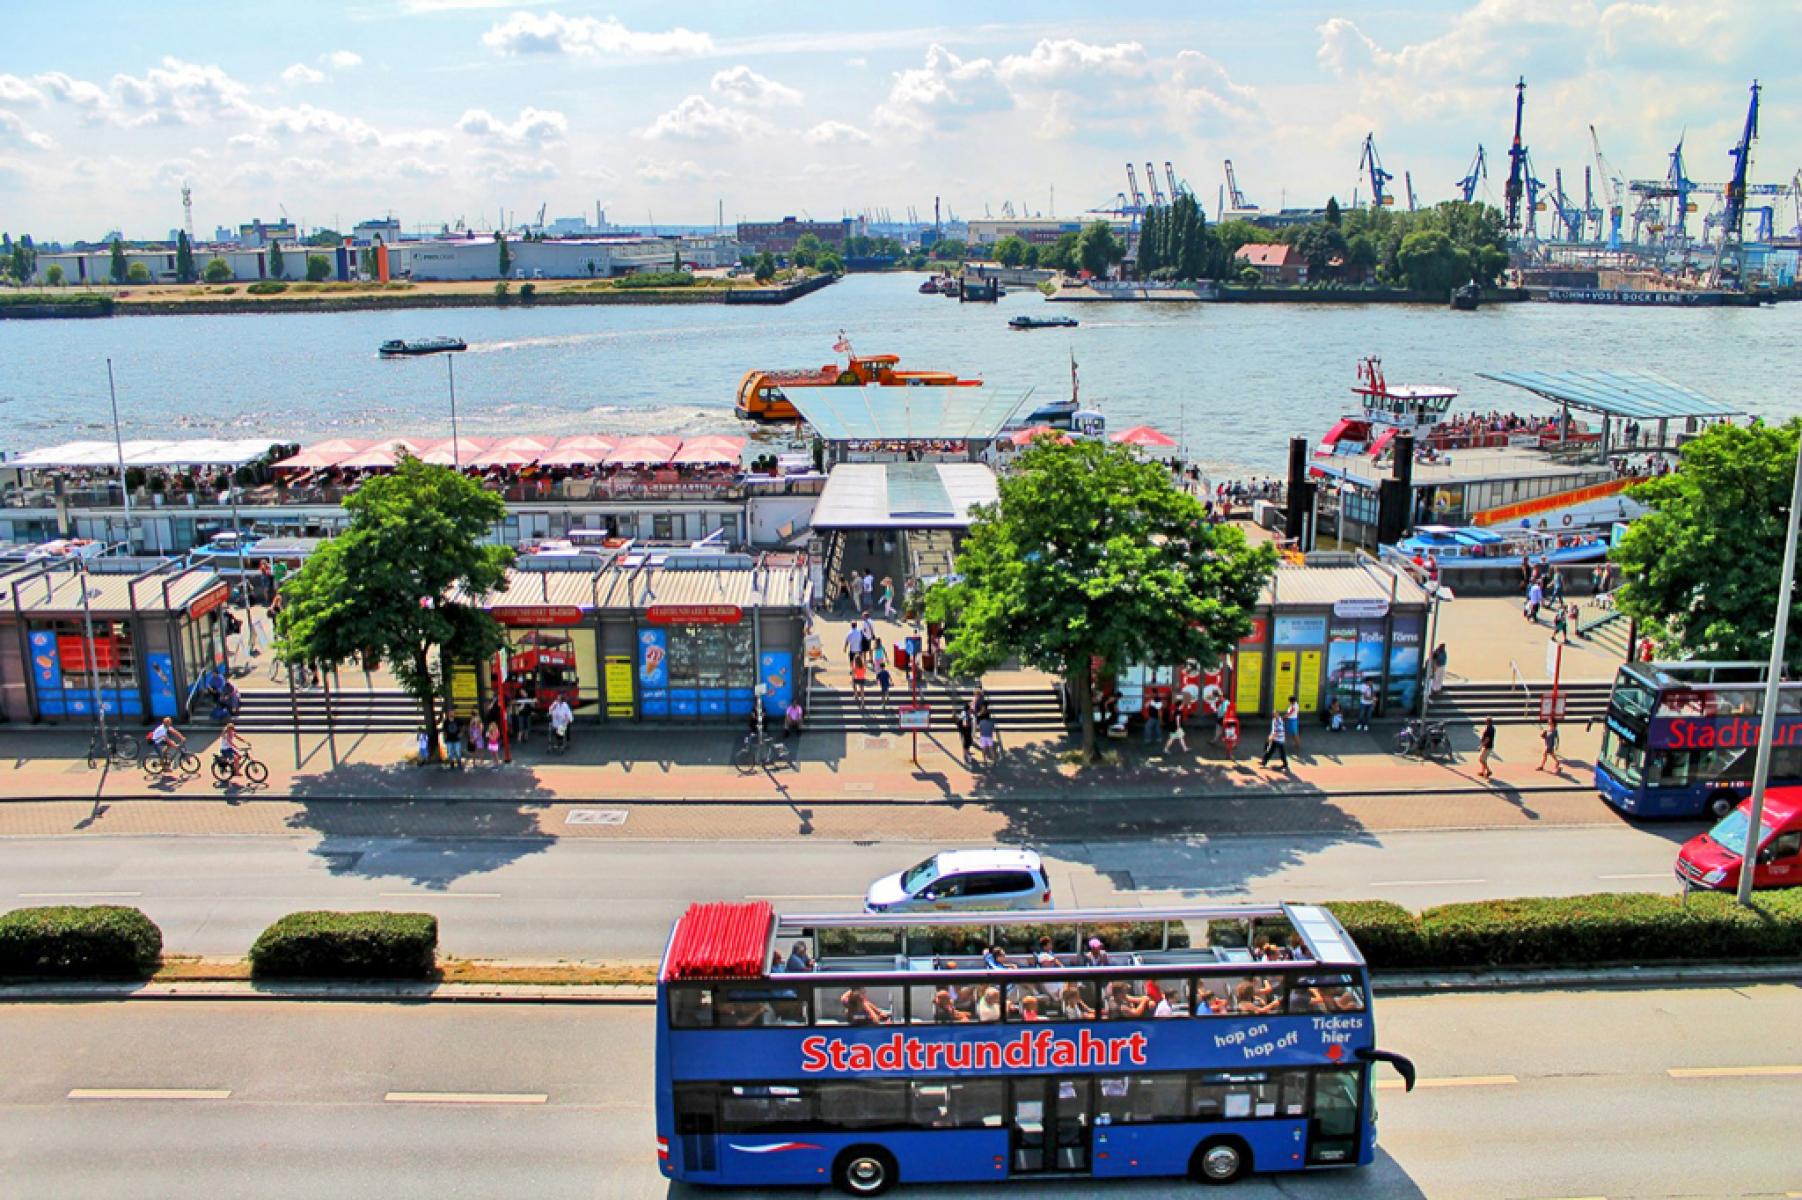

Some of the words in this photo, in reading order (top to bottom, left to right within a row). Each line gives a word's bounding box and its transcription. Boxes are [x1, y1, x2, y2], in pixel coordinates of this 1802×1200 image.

[1311, 1016, 1363, 1029] Tickets
[1214, 1030, 1246, 1048] hop
[1248, 1023, 1269, 1037] on
[1243, 1042, 1275, 1059] hop
[1277, 1031, 1299, 1049] off
[1321, 1031, 1352, 1044] hier
[802, 1030, 1146, 1071] Stadtrundfahrt
